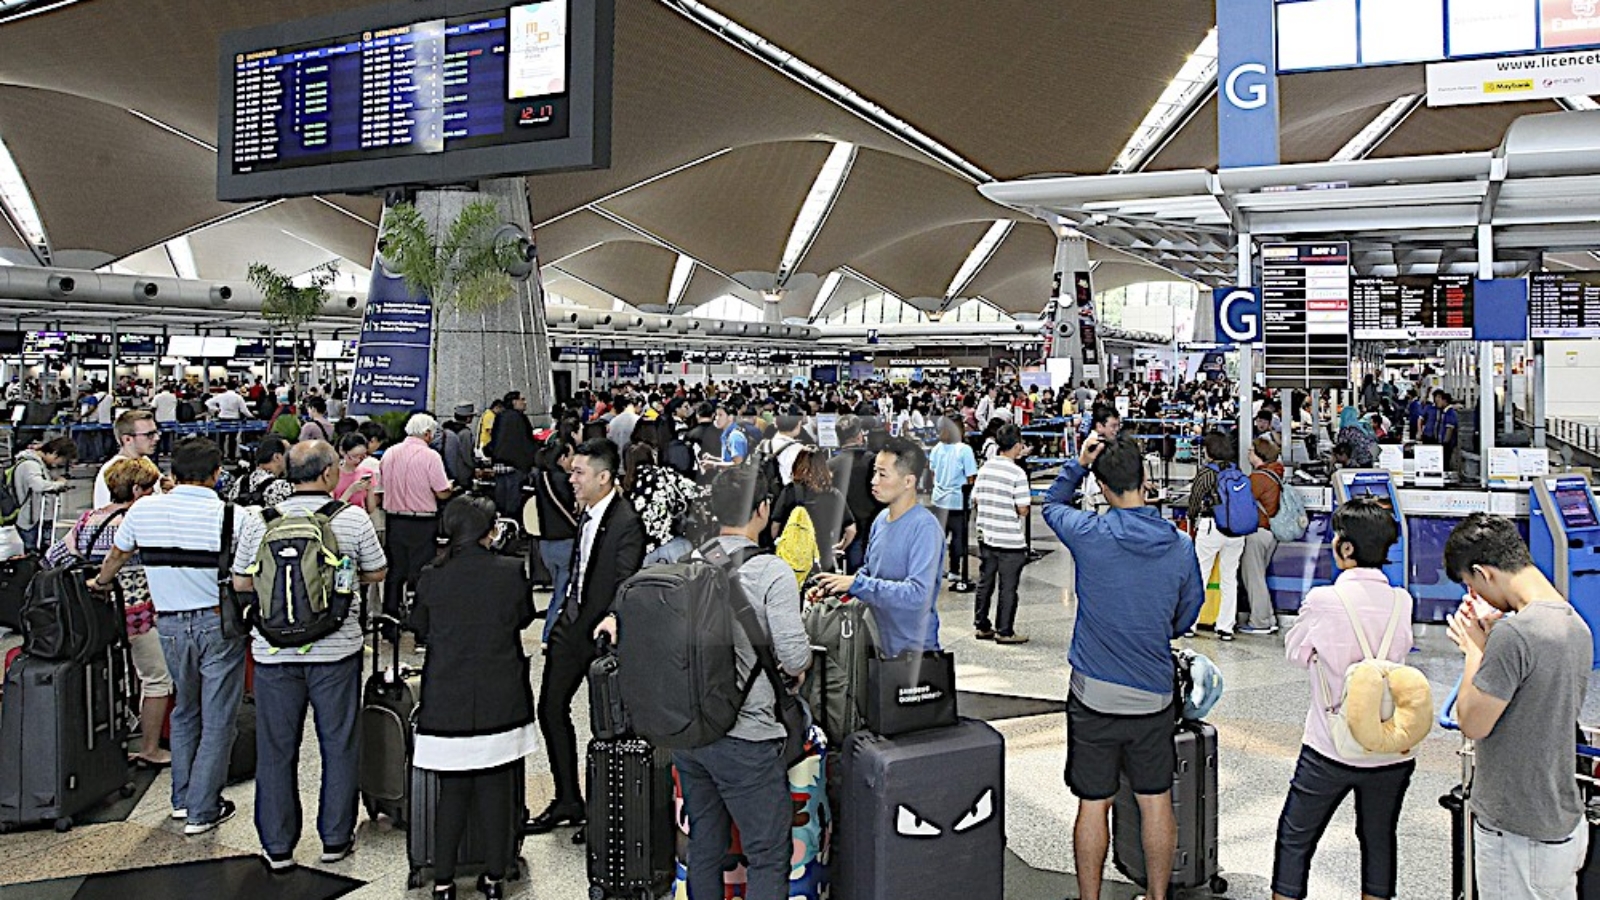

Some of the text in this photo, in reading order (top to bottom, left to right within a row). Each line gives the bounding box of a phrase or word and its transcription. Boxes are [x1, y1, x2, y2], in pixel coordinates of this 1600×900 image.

[1225, 63, 1267, 109] G
[1496, 82, 1530, 91] Maybank
[1220, 290, 1257, 341] G
[890, 358, 911, 366] BOOKS
[917, 358, 950, 366] MAGAZINES
